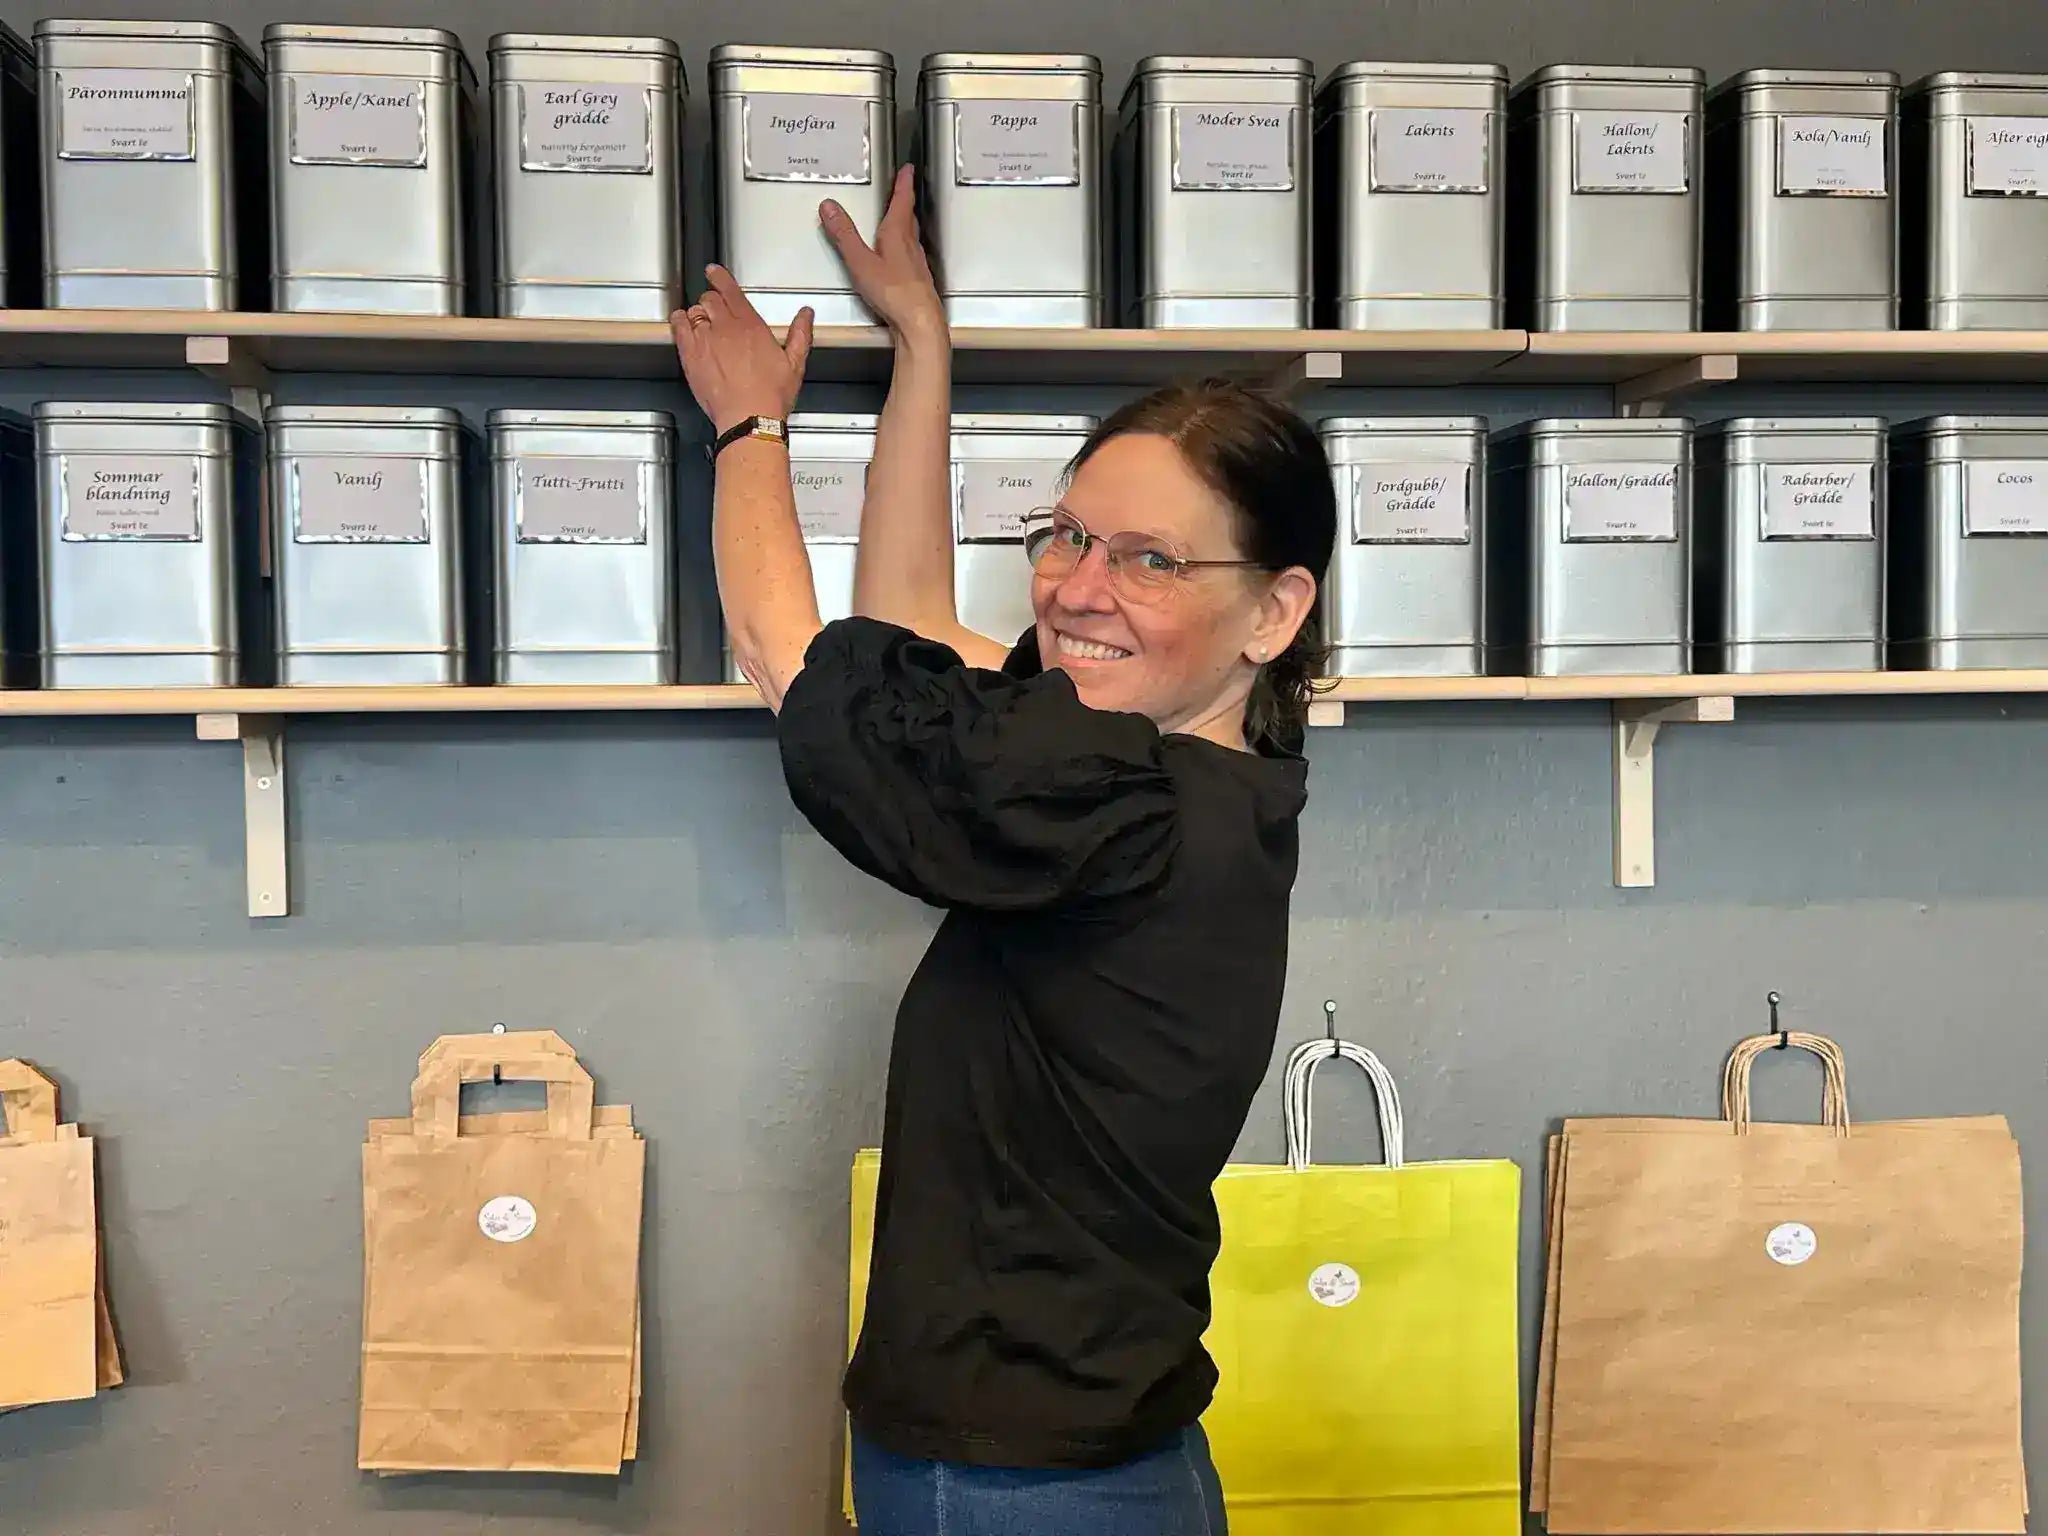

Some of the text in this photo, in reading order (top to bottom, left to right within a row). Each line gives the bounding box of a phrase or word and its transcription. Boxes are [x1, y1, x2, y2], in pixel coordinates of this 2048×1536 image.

[68, 86, 186, 100] Päronmumma
[545, 89, 617, 109] Earl Grey
[554, 109, 609, 129] grädde
[770, 115, 835, 134] Ingefära
[990, 115, 1038, 131] Pappa
[1197, 112, 1280, 128] Moder Svea
[1405, 123, 1455, 136] Lakrits
[1602, 122, 1659, 139] Hallon/
[111, 139, 136, 147] Svart
[1792, 129, 1871, 148] Kola/Vanilj
[1985, 130, 2048, 148] After eig
[1606, 141, 1654, 155] Lakrits
[1221, 170, 1243, 178] Svart
[94, 471, 163, 483] Sommar
[334, 471, 383, 491] Vanilj
[532, 474, 625, 491] Tutti-Frutti
[792, 471, 843, 490] lkagris
[998, 476, 1032, 488] Paus
[1781, 472, 1856, 488] Rabarber/
[1997, 472, 2033, 484] Cocos
[1373, 476, 1447, 496] Jordgubb/
[86, 485, 171, 505] blandning
[1793, 490, 1843, 505] Grädde
[1386, 496, 1436, 512] Grädde
[111, 521, 136, 529] Svart
[341, 523, 366, 531] Svart
